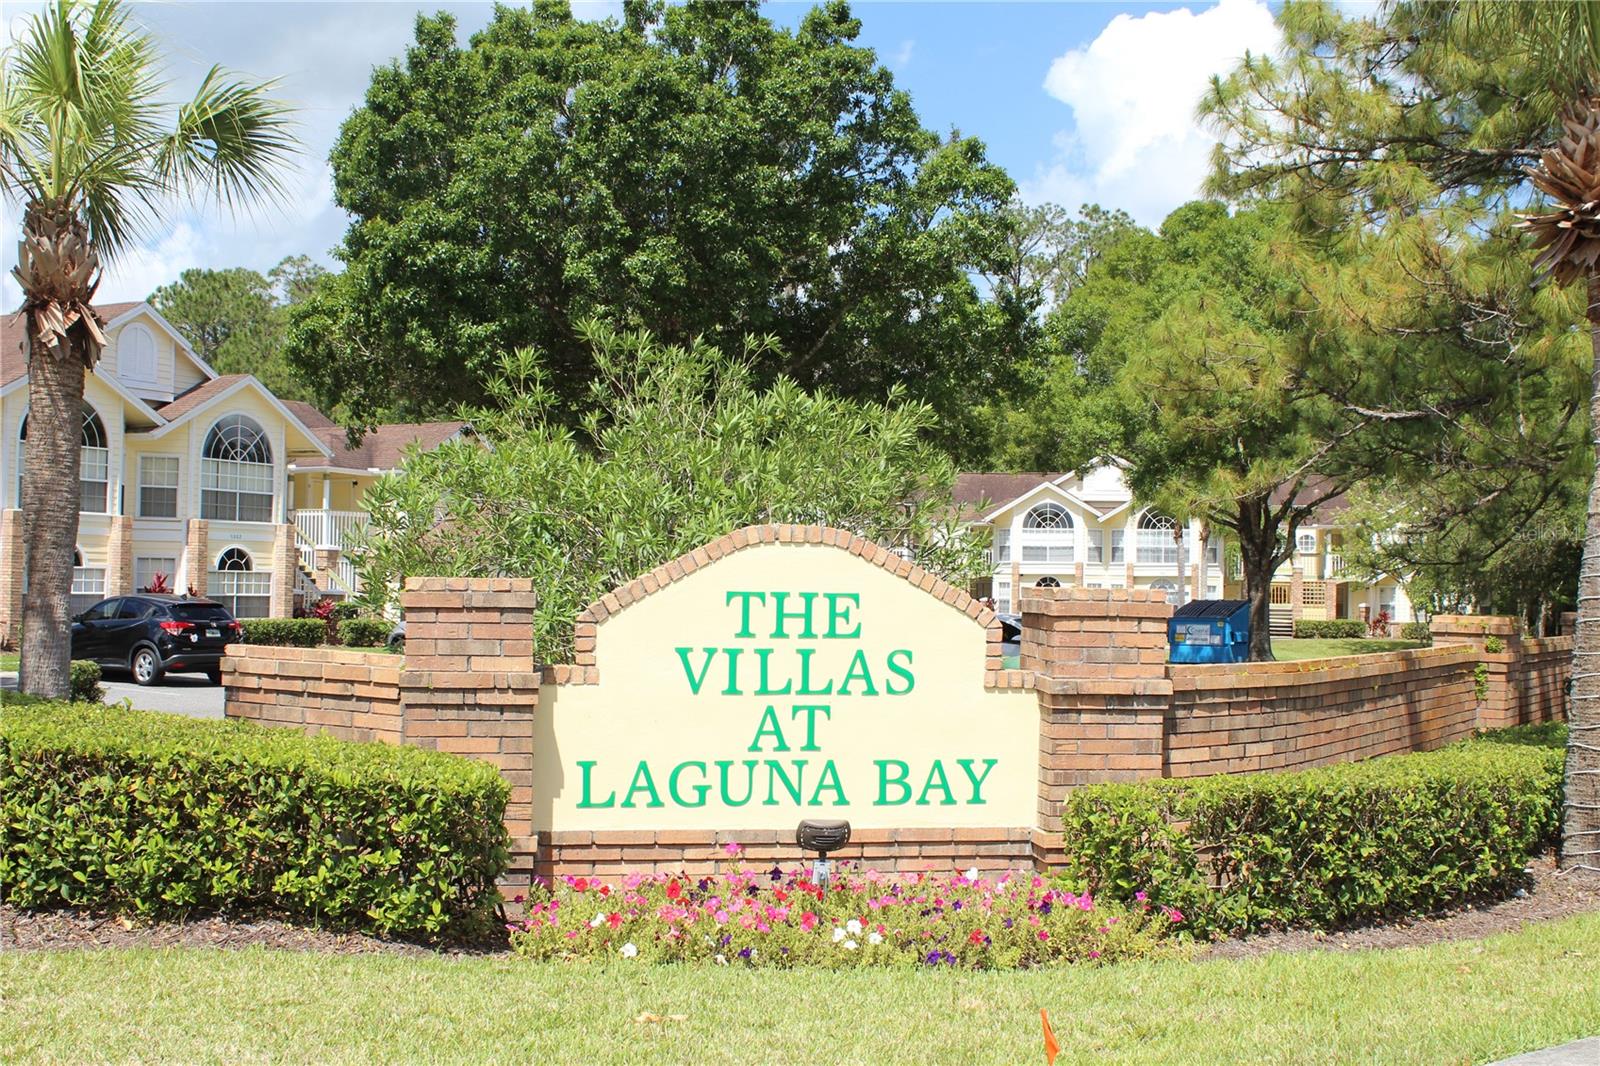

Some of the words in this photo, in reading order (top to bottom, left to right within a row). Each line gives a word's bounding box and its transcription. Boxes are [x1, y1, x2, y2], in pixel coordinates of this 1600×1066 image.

[725, 590, 862, 639] THE
[675, 646, 916, 696] VILLAS
[747, 704, 831, 753] AT
[575, 759, 851, 809] LAGUNA
[873, 758, 998, 806] BAY
